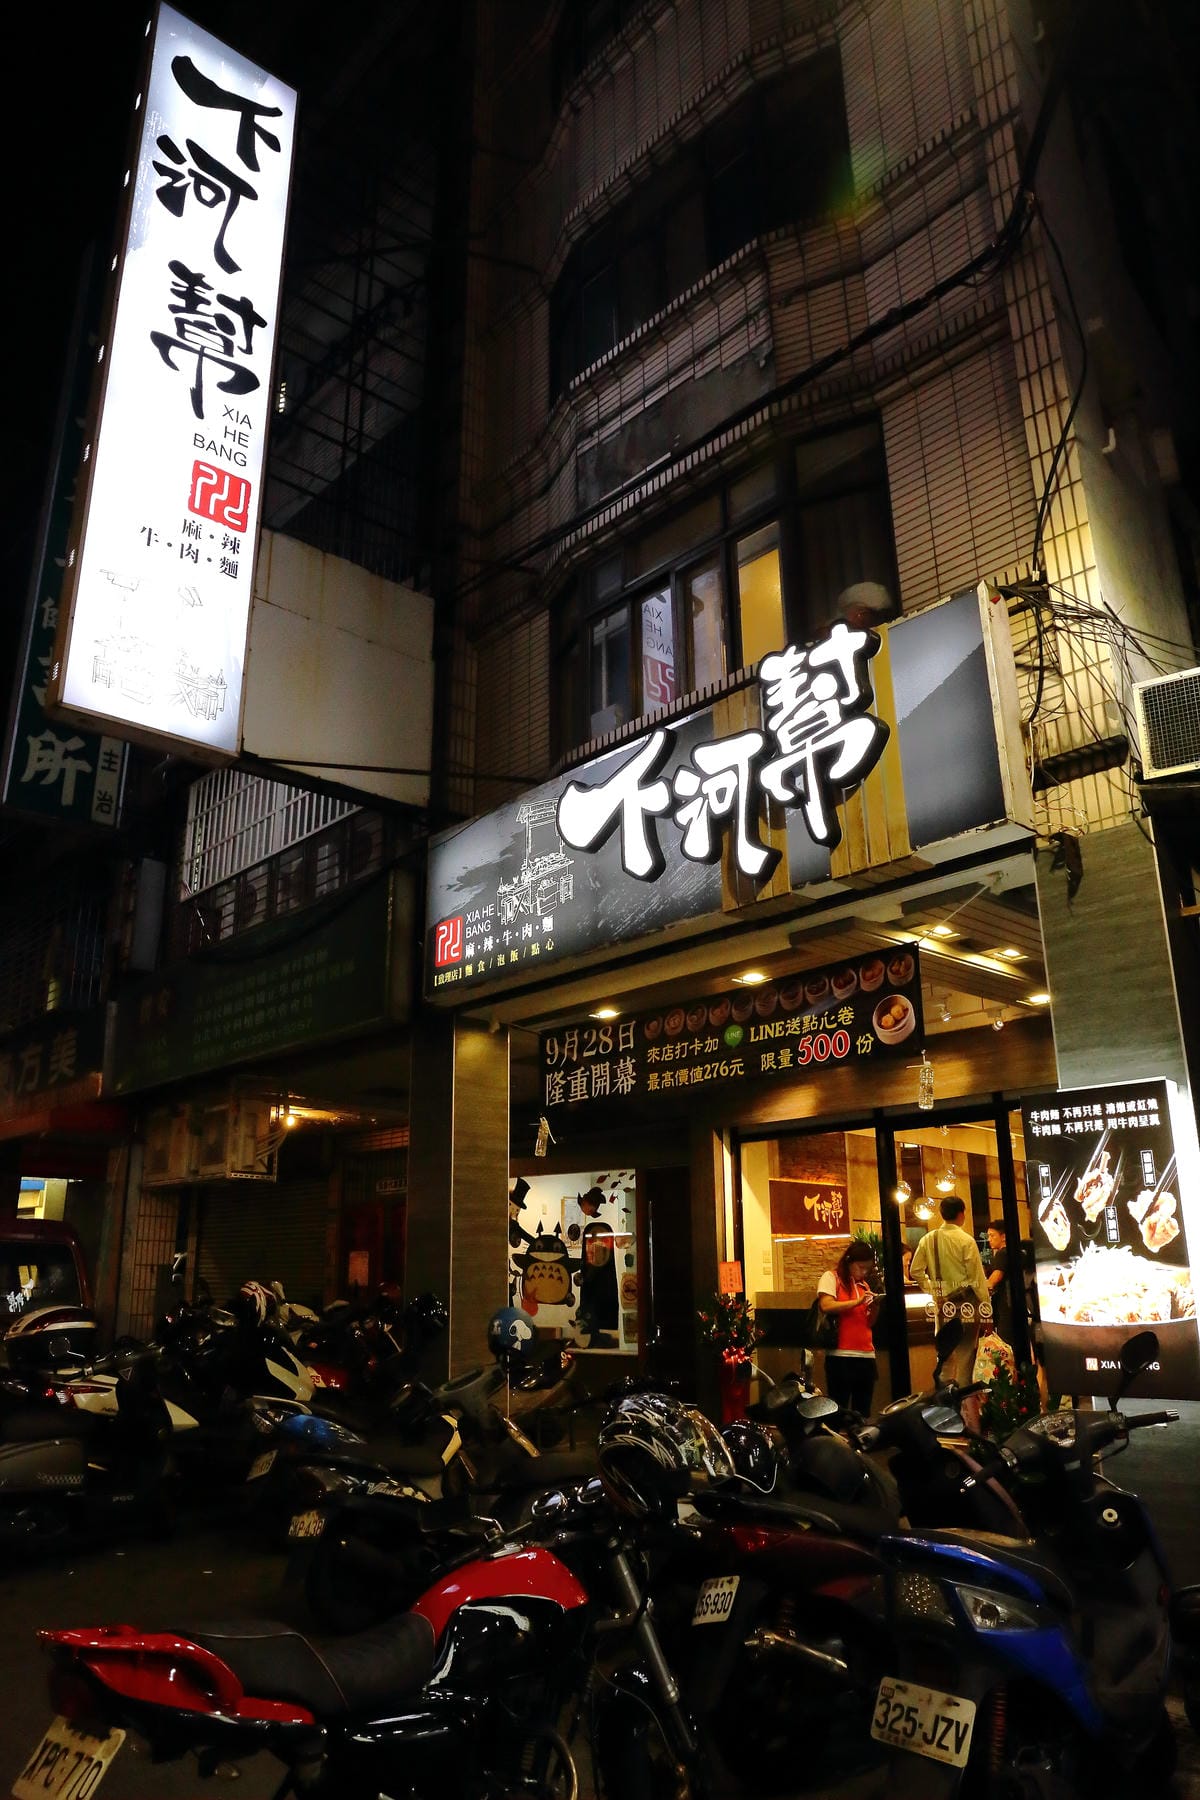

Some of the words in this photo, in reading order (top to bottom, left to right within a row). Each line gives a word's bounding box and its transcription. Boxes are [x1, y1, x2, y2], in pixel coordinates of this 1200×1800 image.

[151, 55, 283, 420] 下河幫
[222, 404, 252, 430] XIA
[193, 433, 248, 467] BANG
[223, 425, 250, 449] HE
[557, 622, 883, 874] 下河幫
[465, 909, 481, 925] XIA
[482, 903, 495, 919] HE
[465, 919, 491, 939] BANG
[546, 1020, 637, 1068] 9月28日
[647, 1036, 719, 1064] 來店打卡加
[545, 1055, 637, 1107] 隆重開幕
[1062, 1103, 1103, 1119] 不再只是
[1063, 1118, 1104, 1134] 不再只是
[803, 1190, 844, 1230] 下河幫
[1100, 1360, 1116, 1370] XIA
[874, 1697, 969, 1755] 325-JZV
